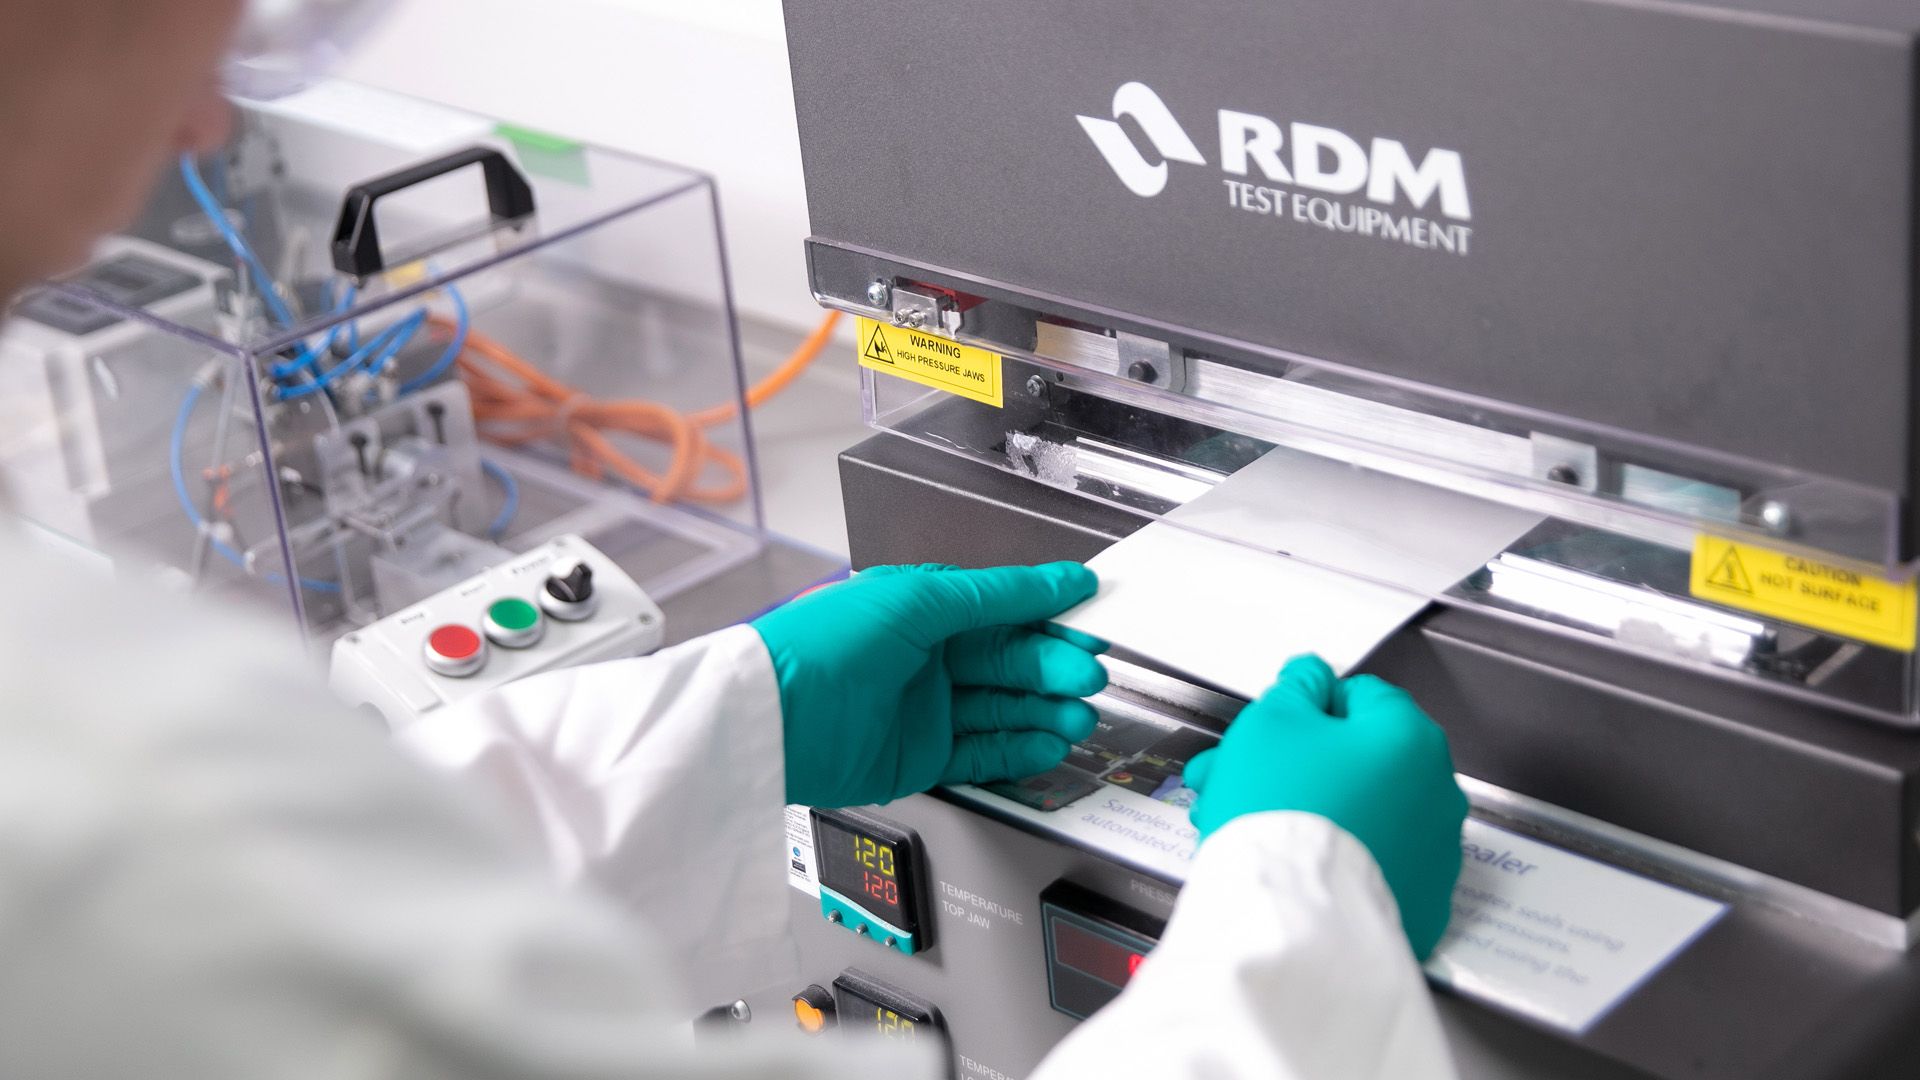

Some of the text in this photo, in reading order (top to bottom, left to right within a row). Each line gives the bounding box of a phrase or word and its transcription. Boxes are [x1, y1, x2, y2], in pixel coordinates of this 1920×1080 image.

[1218, 108, 1472, 221] RDM
[1222, 179, 1473, 256] TEST EQUIPMENT
[910, 334, 961, 359] WARNING
[896, 350, 985, 383] HIGH PRESSURE JAWS
[1784, 556, 1862, 587] CAUTION
[1102, 798, 1173, 832] Samples
[1080, 812, 1179, 853] automated
[855, 834, 895, 877] 120
[1462, 842, 1539, 877] ealer
[864, 871, 898, 905] 120
[940, 880, 1025, 926] TEMPERATURE
[1131, 879, 1175, 906] PRESS
[943, 900, 991, 929] TOP JAW
